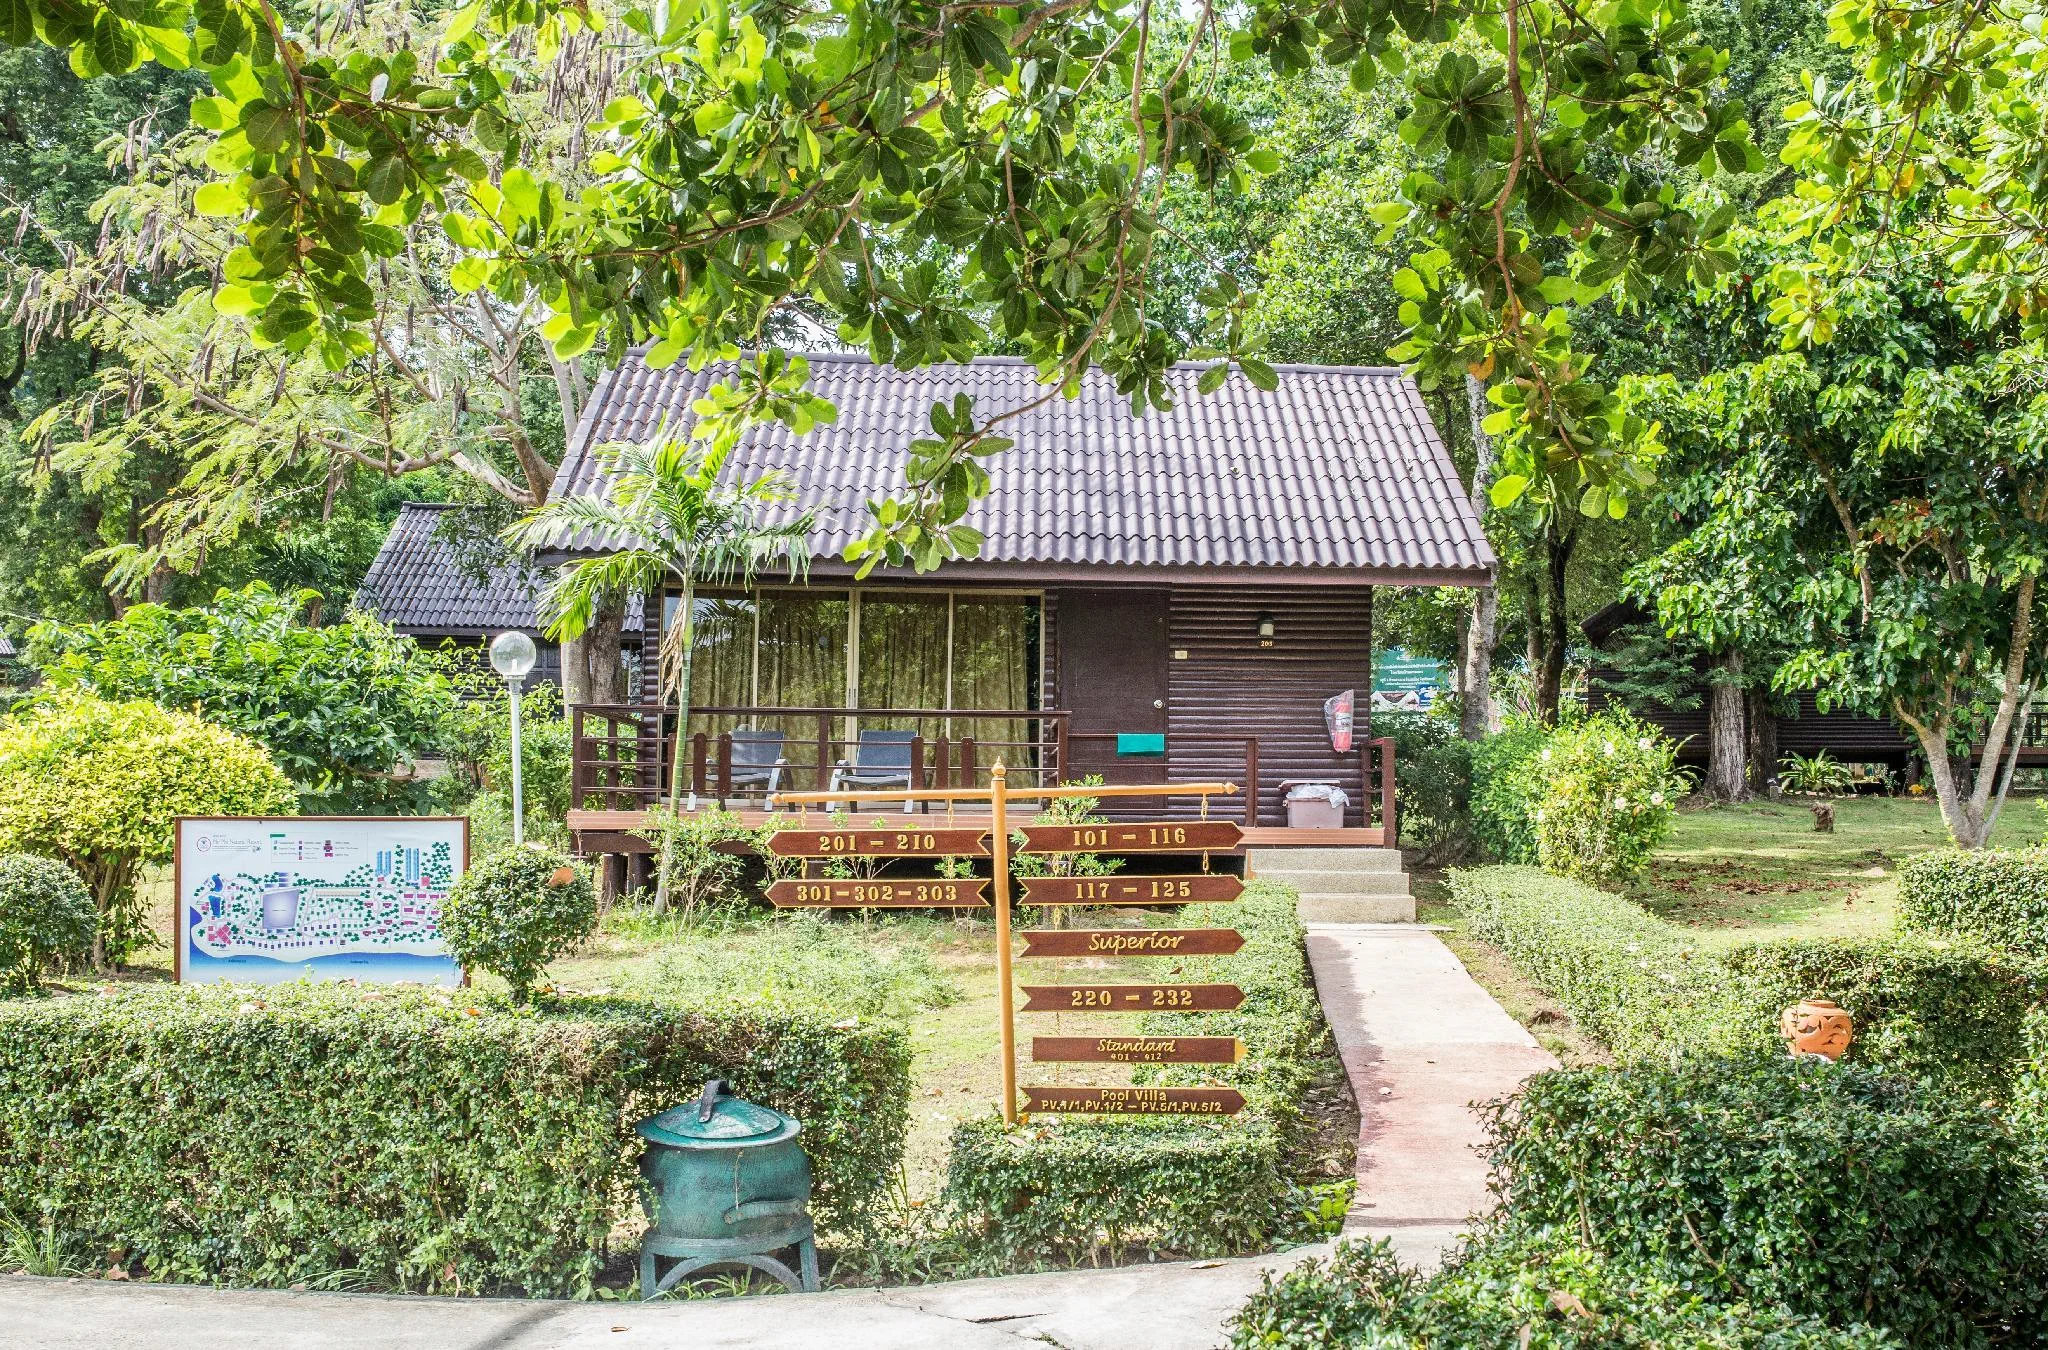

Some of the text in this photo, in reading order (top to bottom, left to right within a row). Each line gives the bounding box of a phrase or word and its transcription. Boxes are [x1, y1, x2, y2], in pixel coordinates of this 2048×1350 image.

[819, 835, 857, 852] 201
[896, 834, 936, 850] 210
[1072, 829, 1108, 847] 101
[1149, 827, 1186, 845] 116
[1075, 882, 1110, 899] 117
[1151, 881, 1191, 898] 125
[1088, 931, 1185, 955] Superior
[1071, 990, 1112, 1007] 220
[1152, 989, 1193, 1006] 232
[1096, 1038, 1176, 1053] Standard
[1101, 1089, 1167, 1101] Pool Villa
[1141, 1101, 1223, 1113] PV.5/1,PV.5/2
